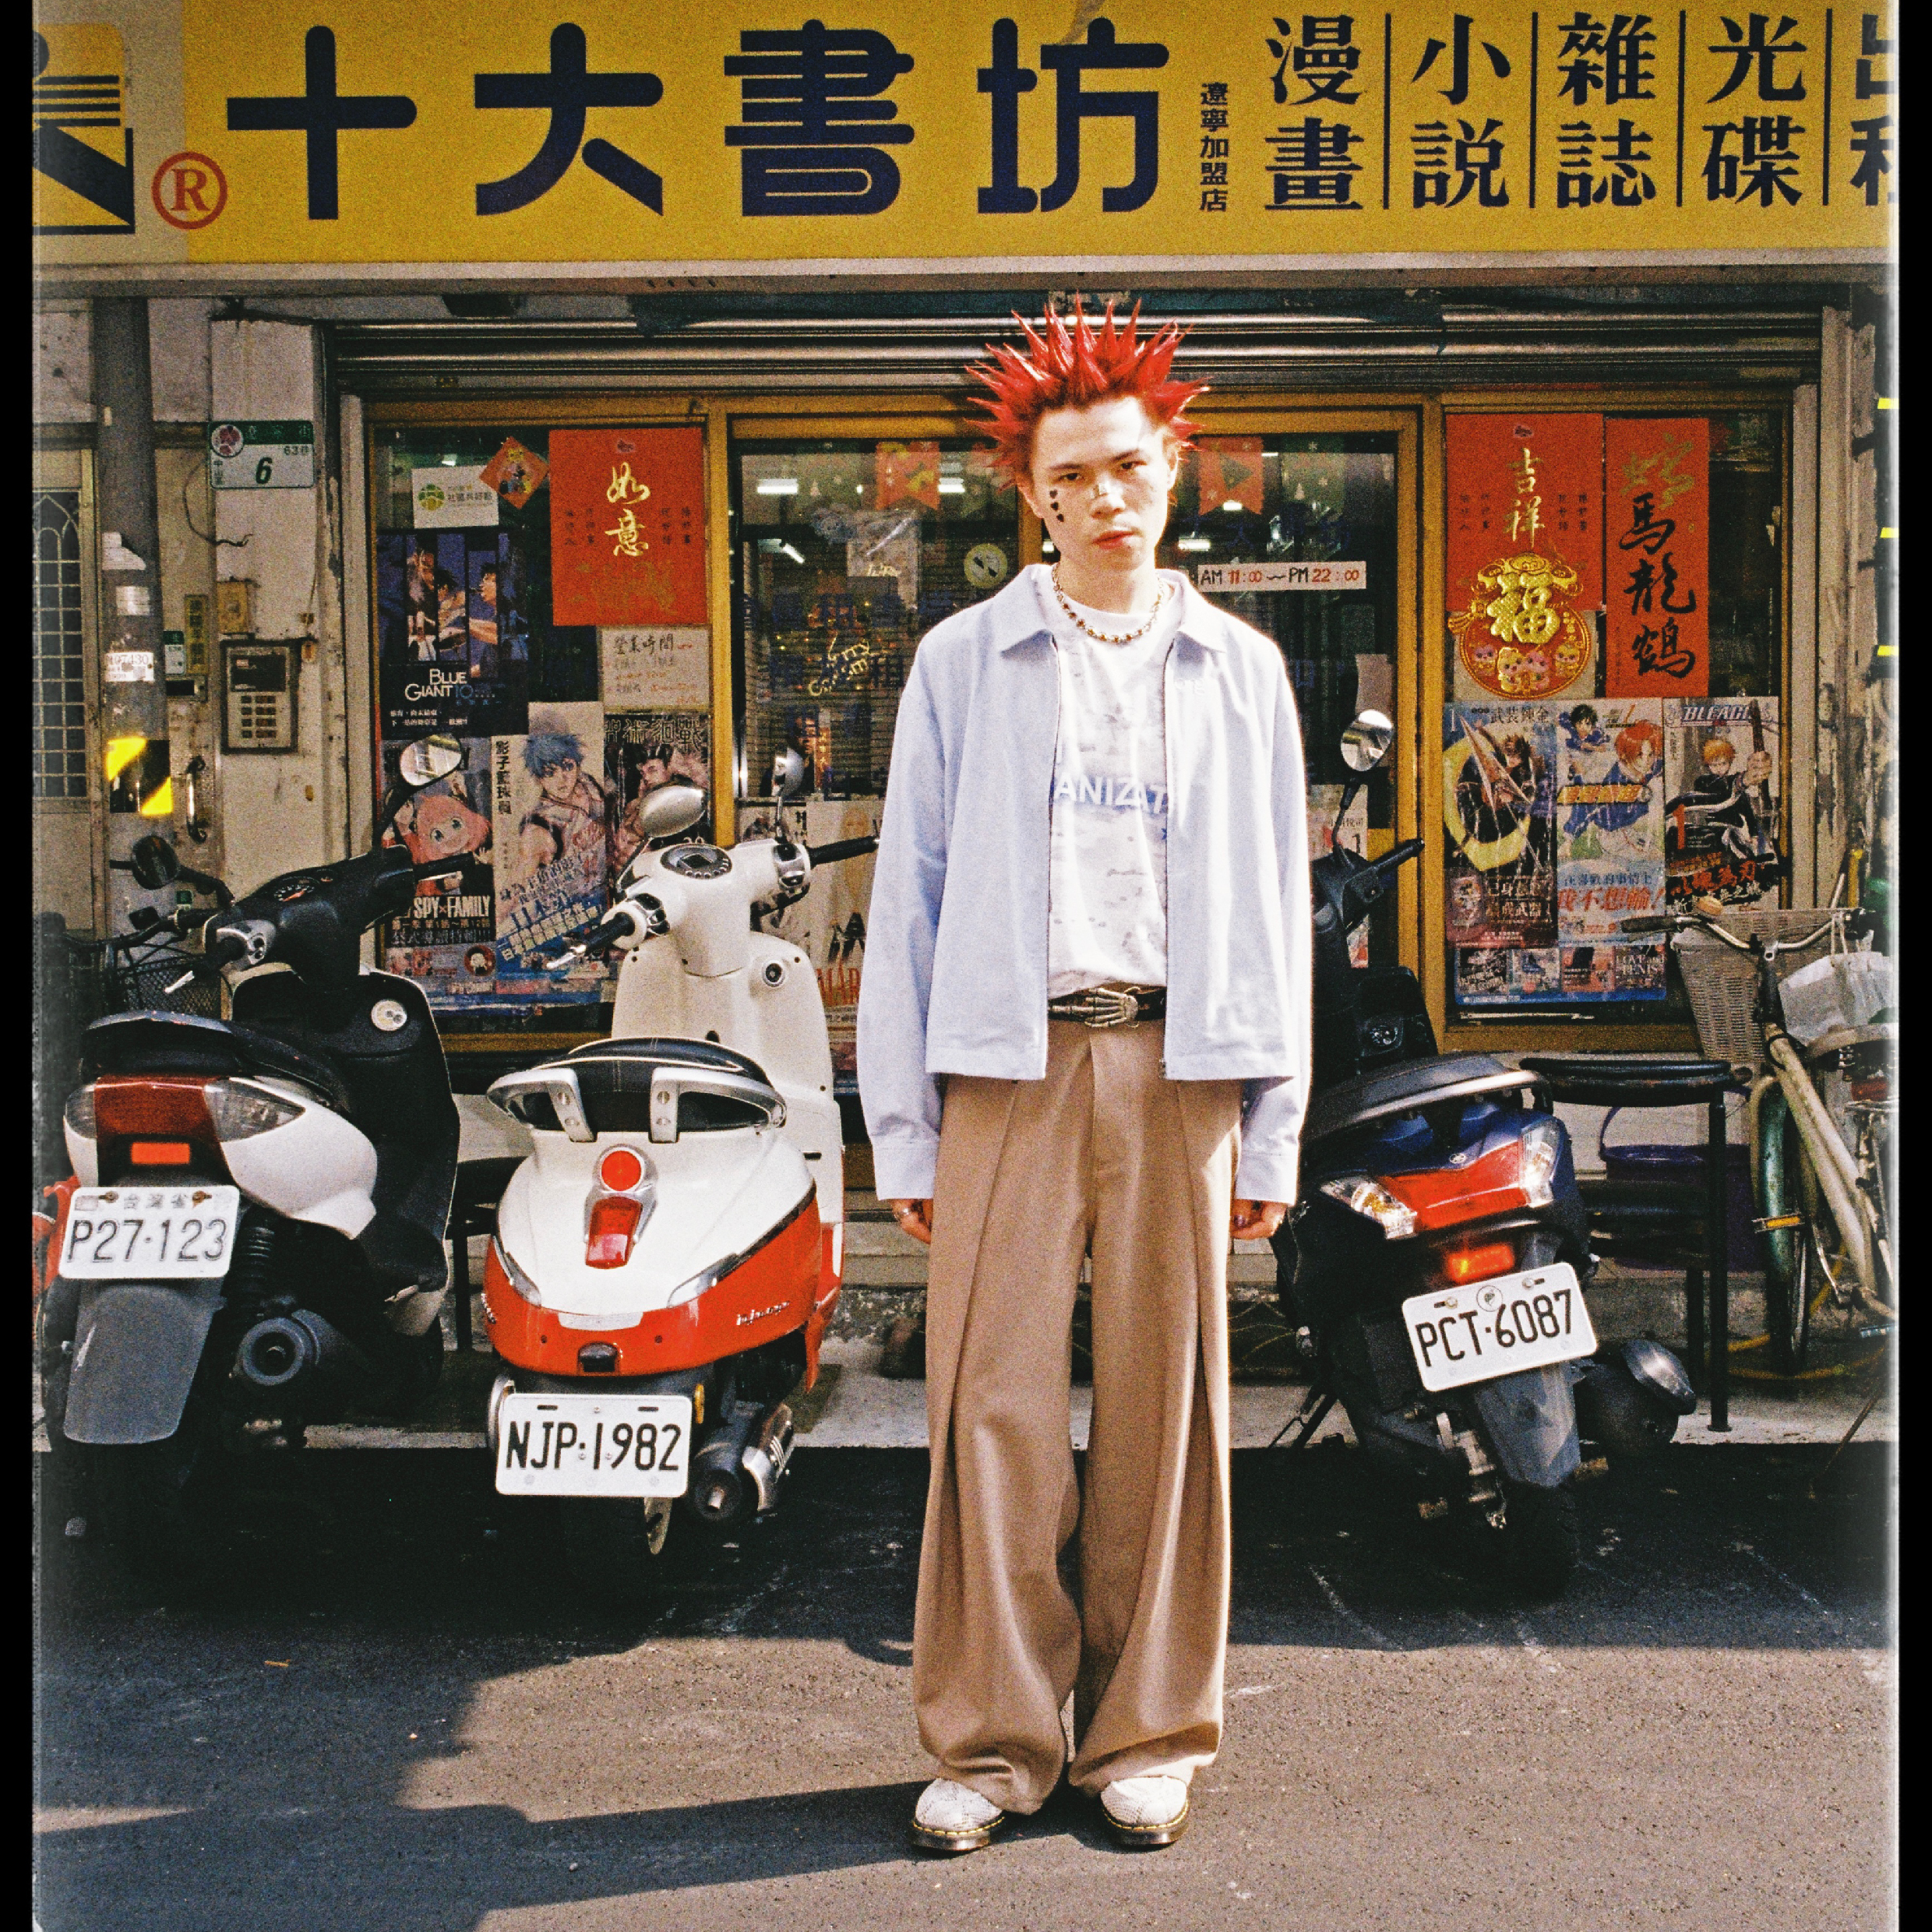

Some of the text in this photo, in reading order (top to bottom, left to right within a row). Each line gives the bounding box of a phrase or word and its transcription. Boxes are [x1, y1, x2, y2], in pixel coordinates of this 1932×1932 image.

[227, 18, 1169, 220] 十大書坊
[1200, 82, 1229, 213] 遼寧加盟店
[1263, 14, 1365, 211] 漫畫
[1558, 11, 1656, 209] 雜誌
[1701, 14, 1807, 208] 光碟
[256, 457, 273, 485] 6
[605, 462, 651, 557] 如意
[1501, 447, 1545, 548] 吉祥
[1200, 569, 1223, 585] AM
[1289, 566, 1309, 583] PM
[1486, 571, 1560, 645] 福
[404, 683, 454, 702] GIANT
[429, 668, 468, 686] BLUE
